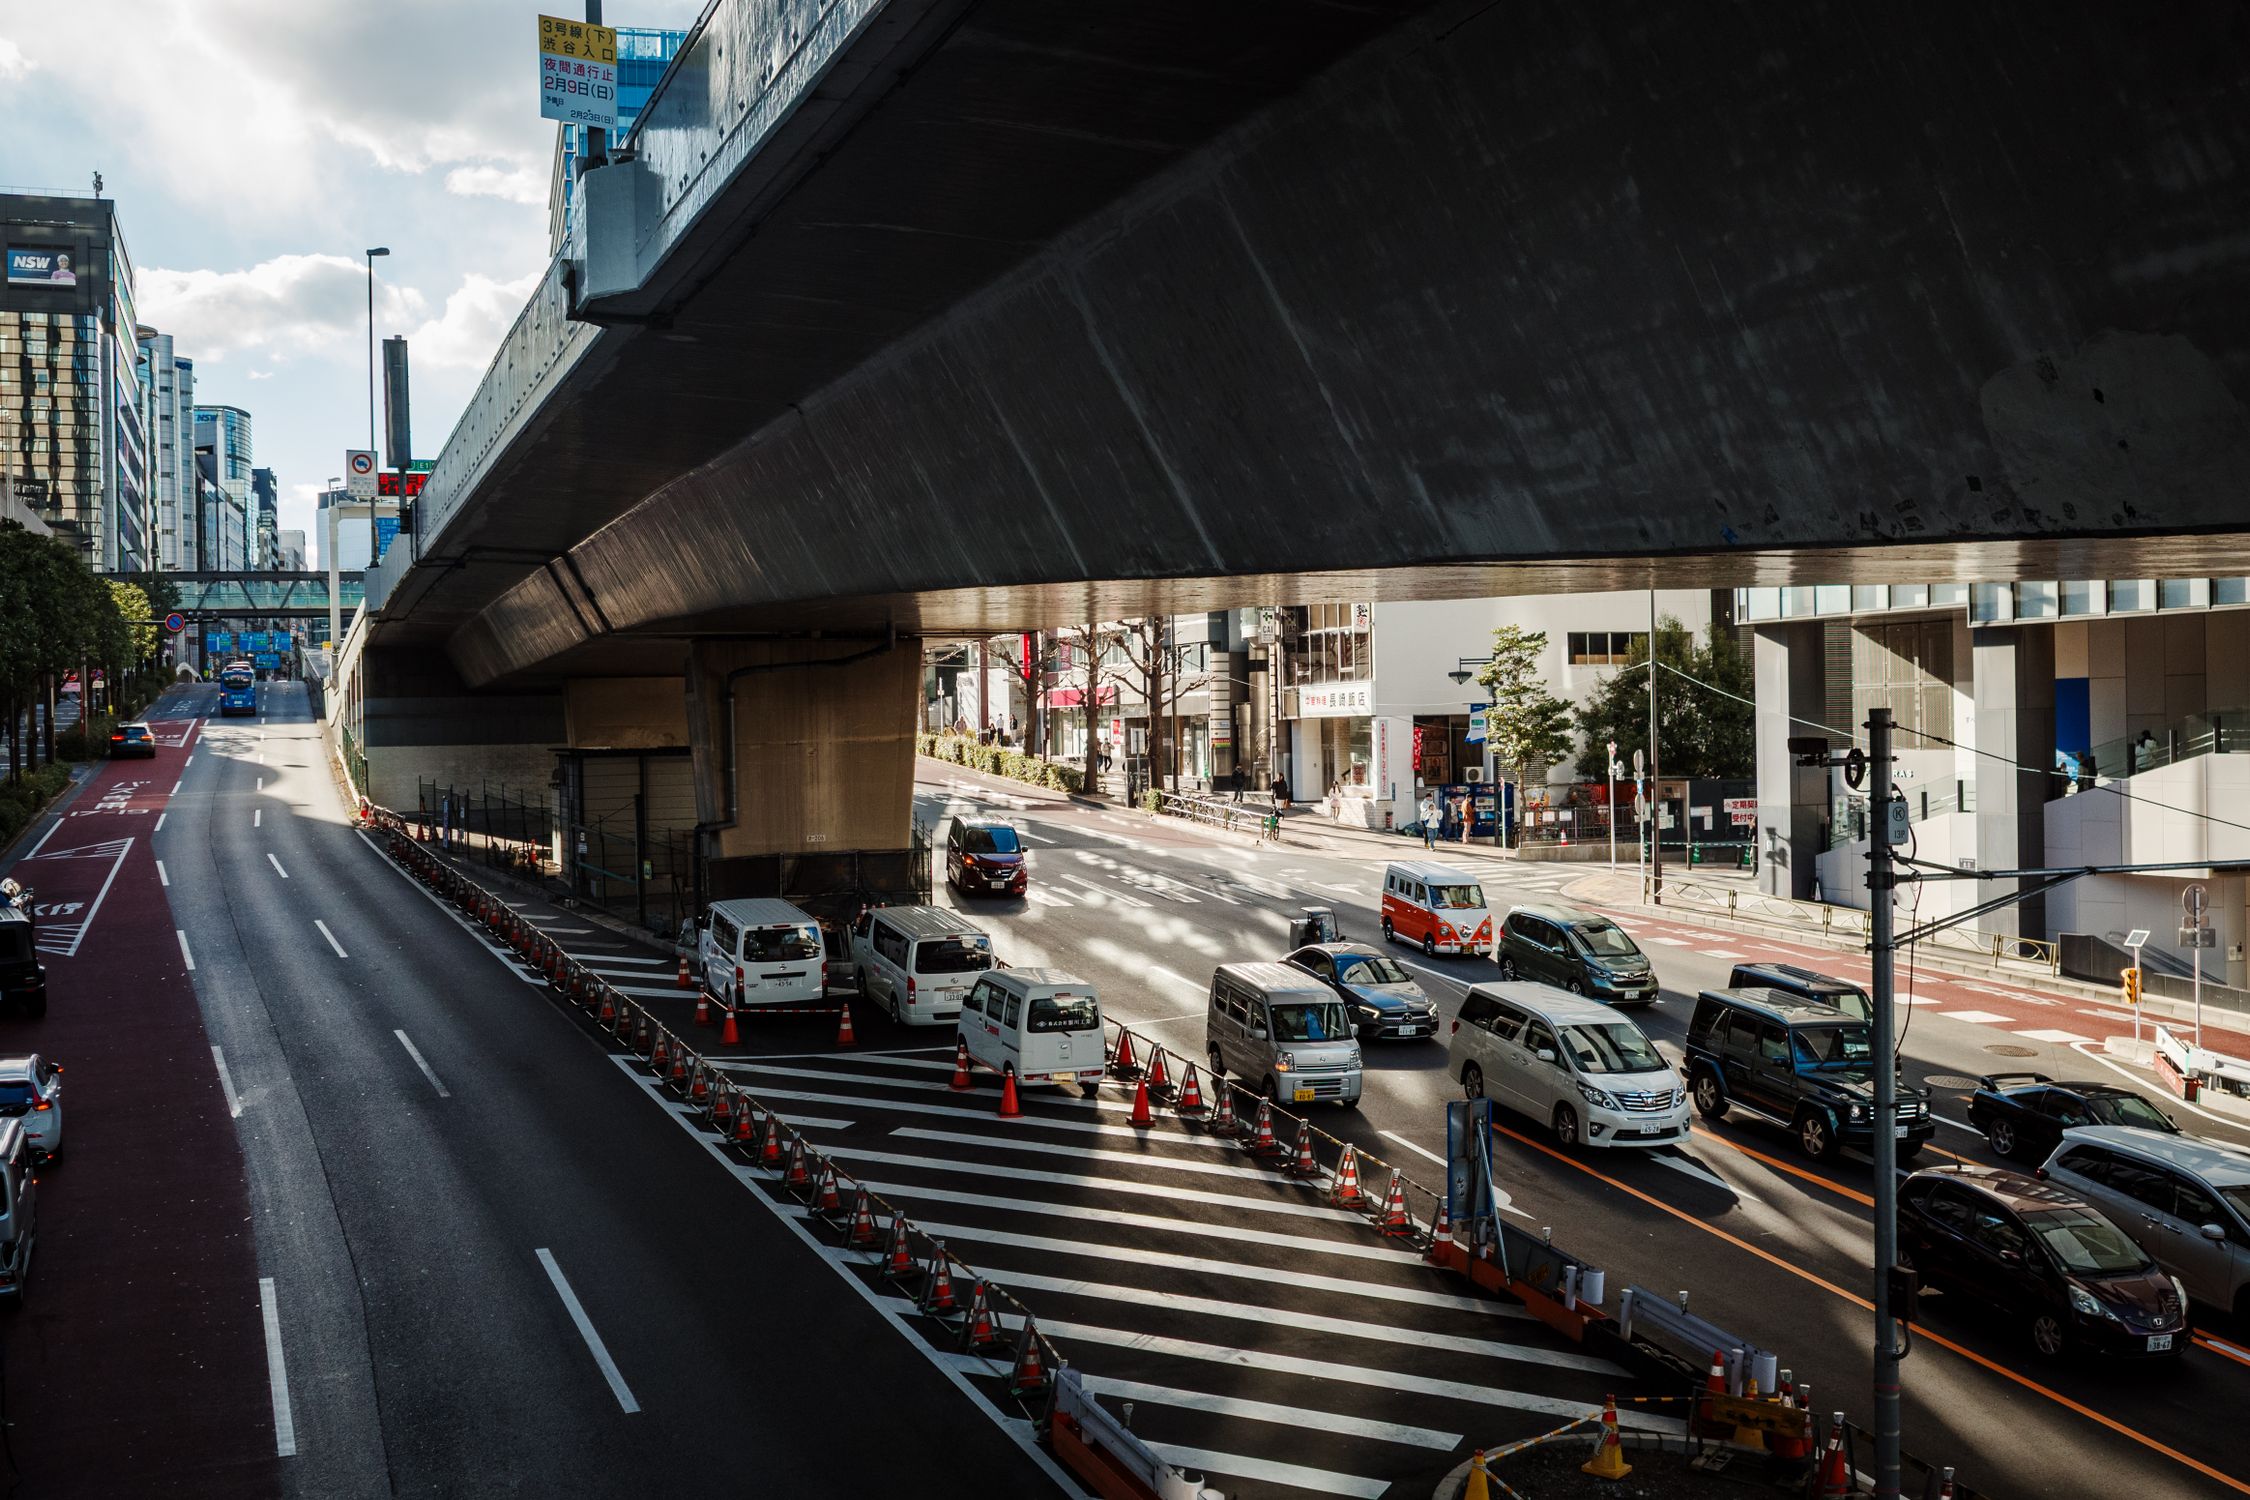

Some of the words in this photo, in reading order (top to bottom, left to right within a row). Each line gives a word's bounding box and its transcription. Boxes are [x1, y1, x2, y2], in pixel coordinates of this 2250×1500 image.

[543, 20, 613, 45] 3号線(下)
[543, 37, 613, 61] 渋谷入口
[544, 57, 614, 82] 夜間通行止
[544, 75, 614, 101] 2月9日(日)
[570, 109, 614, 125] 2月23日(日)
[13, 255, 51, 269] NSW
[1731, 800, 1758, 810] 定期契
[1732, 813, 1755, 823] 受付中
